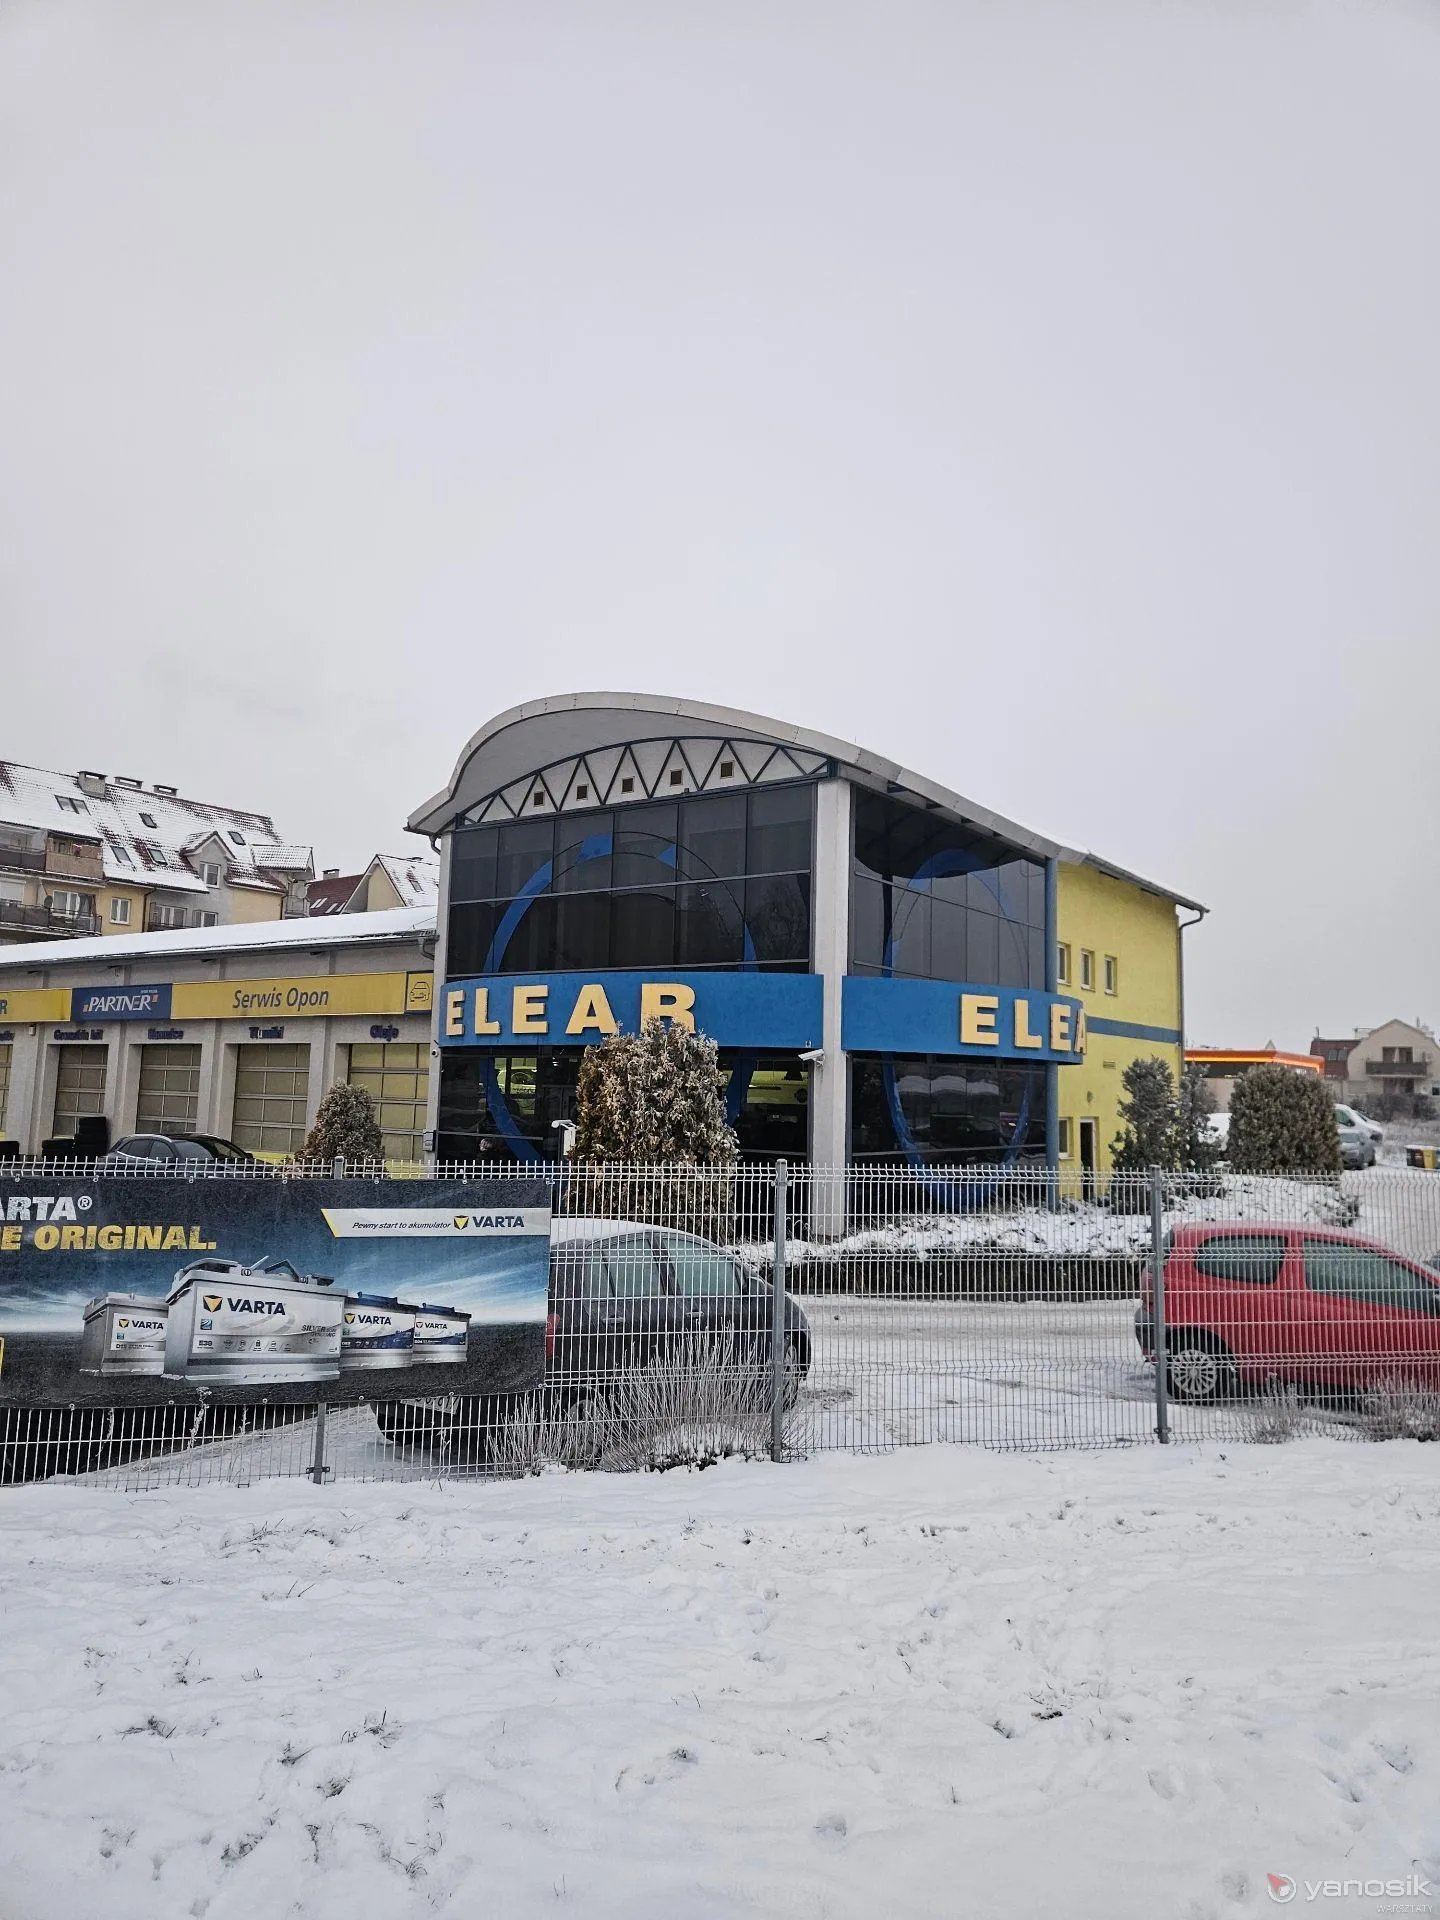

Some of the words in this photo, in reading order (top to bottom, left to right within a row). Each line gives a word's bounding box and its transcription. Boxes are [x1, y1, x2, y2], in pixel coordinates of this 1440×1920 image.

[89, 994, 151, 1012] PARTNER
[233, 987, 282, 1009] Serwis
[286, 987, 329, 1011] Opon
[446, 983, 696, 1036] ELEAR
[352, 1222, 378, 1230] Pewny
[408, 1221, 451, 1229] akumulator
[472, 1215, 525, 1228] VARTA
[0, 1225, 23, 1250] E
[34, 1225, 217, 1250] ORIGINAL.
[227, 1297, 286, 1316] VARTA
[132, 1320, 164, 1330] VARTA
[358, 1314, 392, 1326] VARTA
[424, 1322, 448, 1330] VARTA
